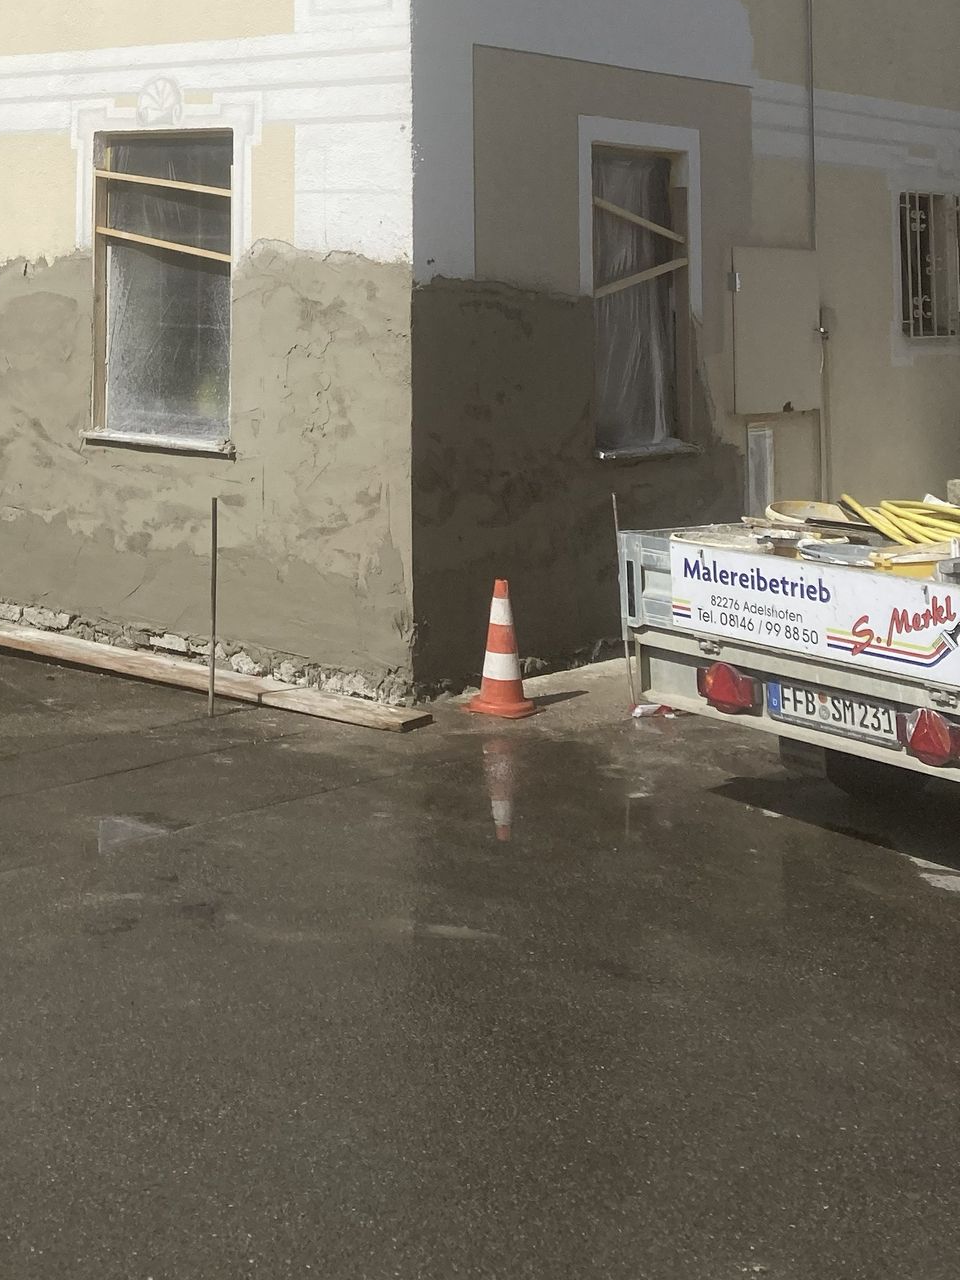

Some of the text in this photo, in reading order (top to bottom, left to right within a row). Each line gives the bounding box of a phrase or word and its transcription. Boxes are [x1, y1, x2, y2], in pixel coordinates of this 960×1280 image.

[683, 557, 832, 604] Malereibetrieb
[697, 607, 717, 624] Tel.
[719, 612, 755, 632] 08146
[710, 594, 804, 624] 82276 Adelshofen
[851, 595, 957, 656] S. Merkl
[781, 686, 817, 716] FFB
